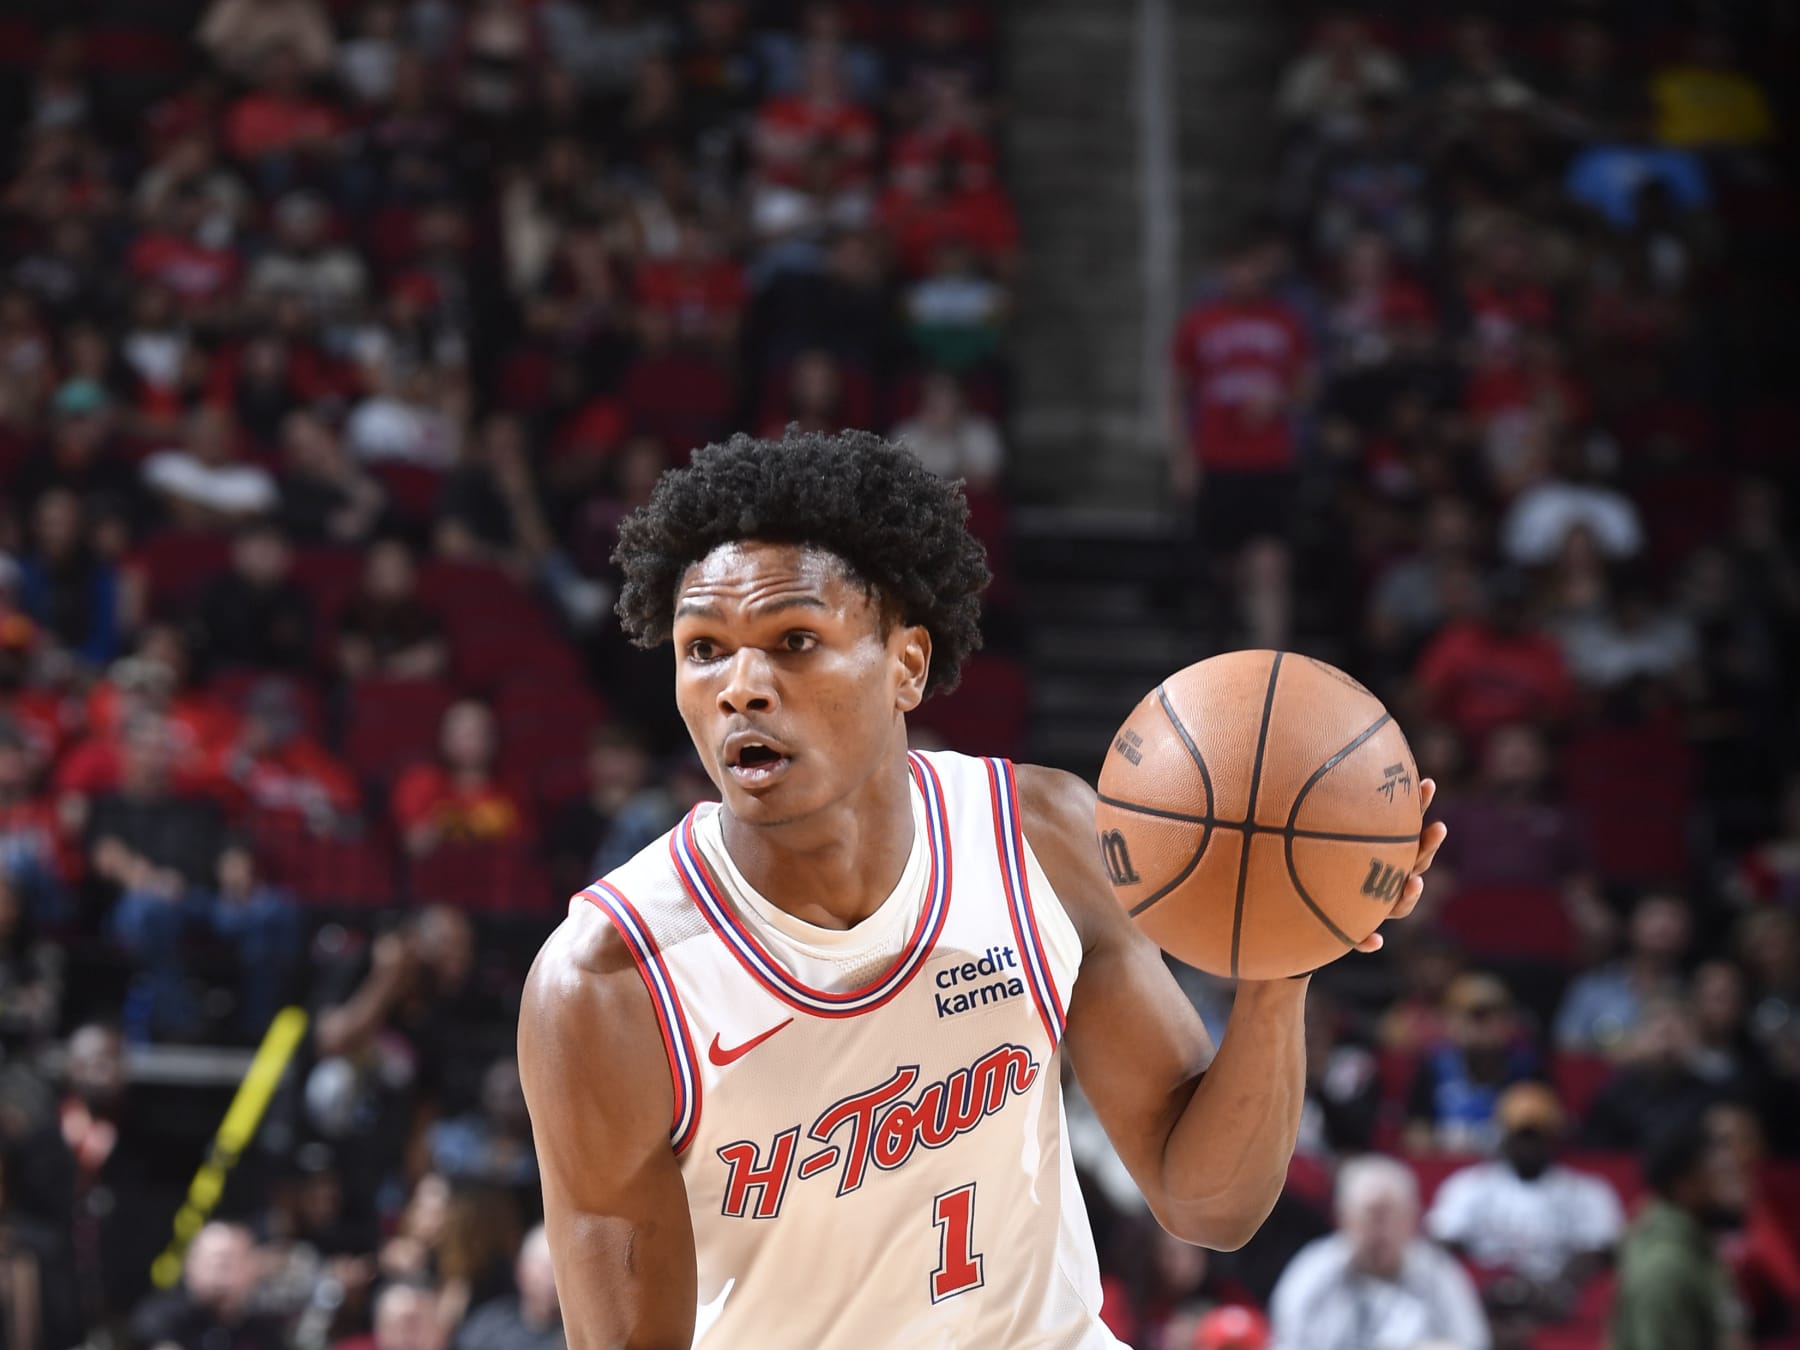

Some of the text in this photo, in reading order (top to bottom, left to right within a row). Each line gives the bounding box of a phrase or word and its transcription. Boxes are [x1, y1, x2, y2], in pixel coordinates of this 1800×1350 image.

[934, 977, 1025, 1018] karma
[935, 946, 1017, 989] credit
[715, 1042, 1040, 1220] H-Town
[930, 1181, 985, 1305] 1
